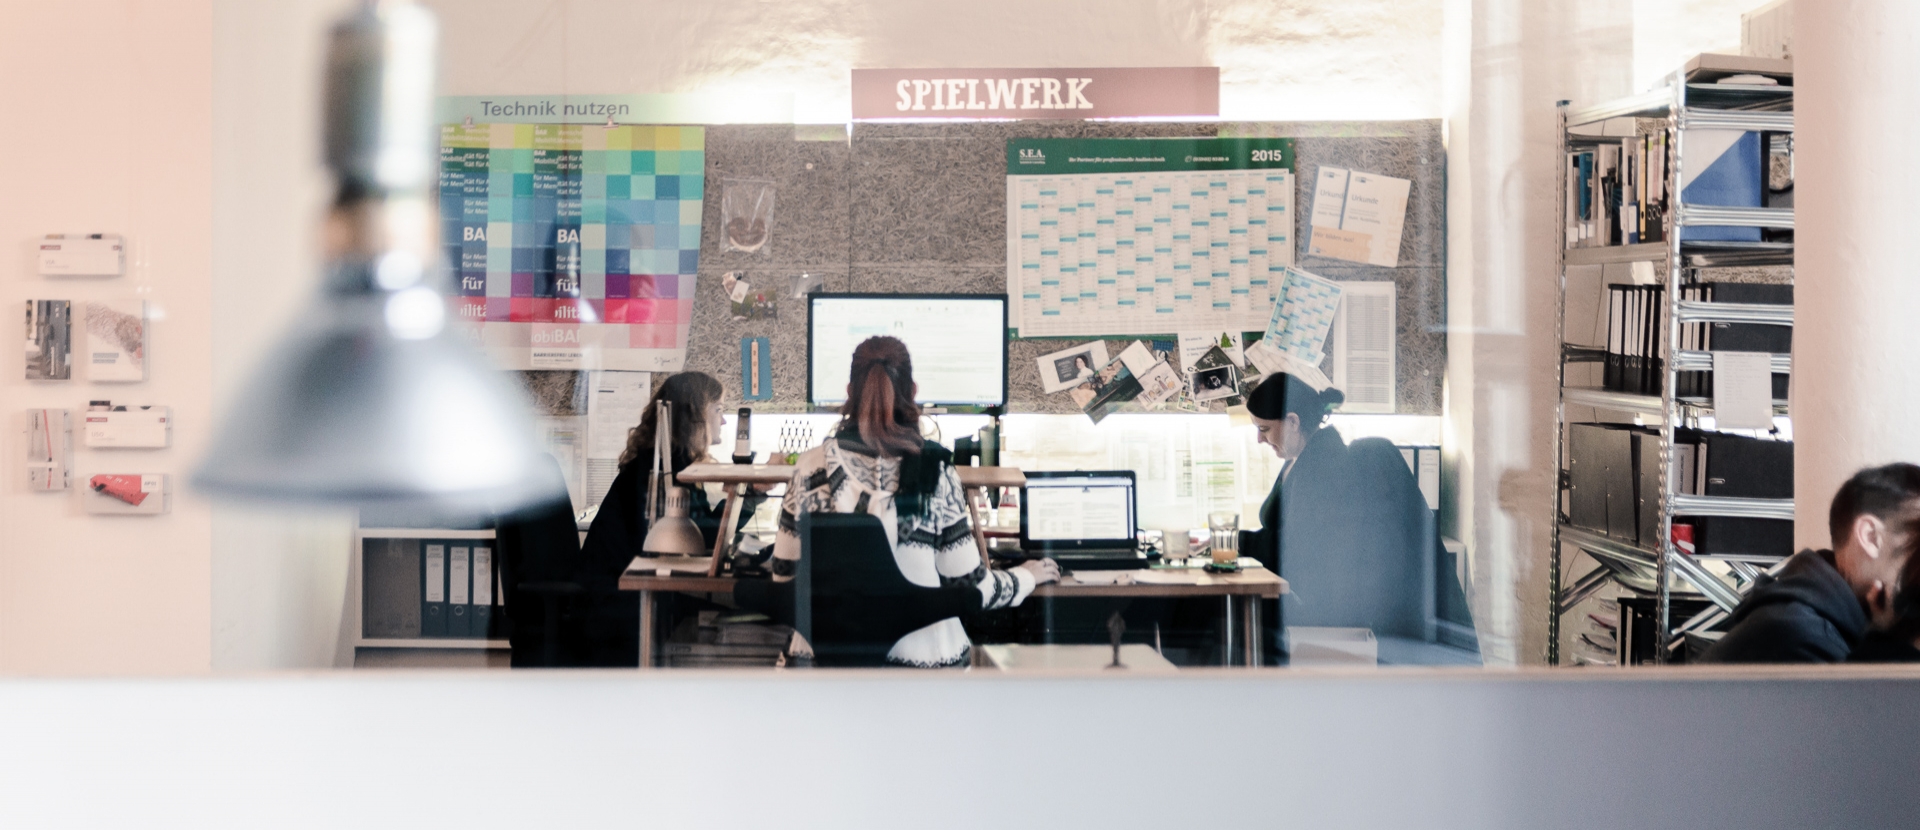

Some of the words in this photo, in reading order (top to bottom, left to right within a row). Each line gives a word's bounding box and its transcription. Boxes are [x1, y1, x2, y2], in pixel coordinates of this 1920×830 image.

[896, 77, 1093, 111] SPIELWERK
[481, 101, 556, 116] Technik
[564, 102, 629, 116] nutzen
[1251, 149, 1282, 162] 2015
[1351, 194, 1379, 205] Urkunde
[463, 226, 488, 242] BA
[557, 228, 581, 244] BA
[462, 276, 484, 290] für
[556, 279, 578, 292] für
[532, 329, 580, 343] obiBA
